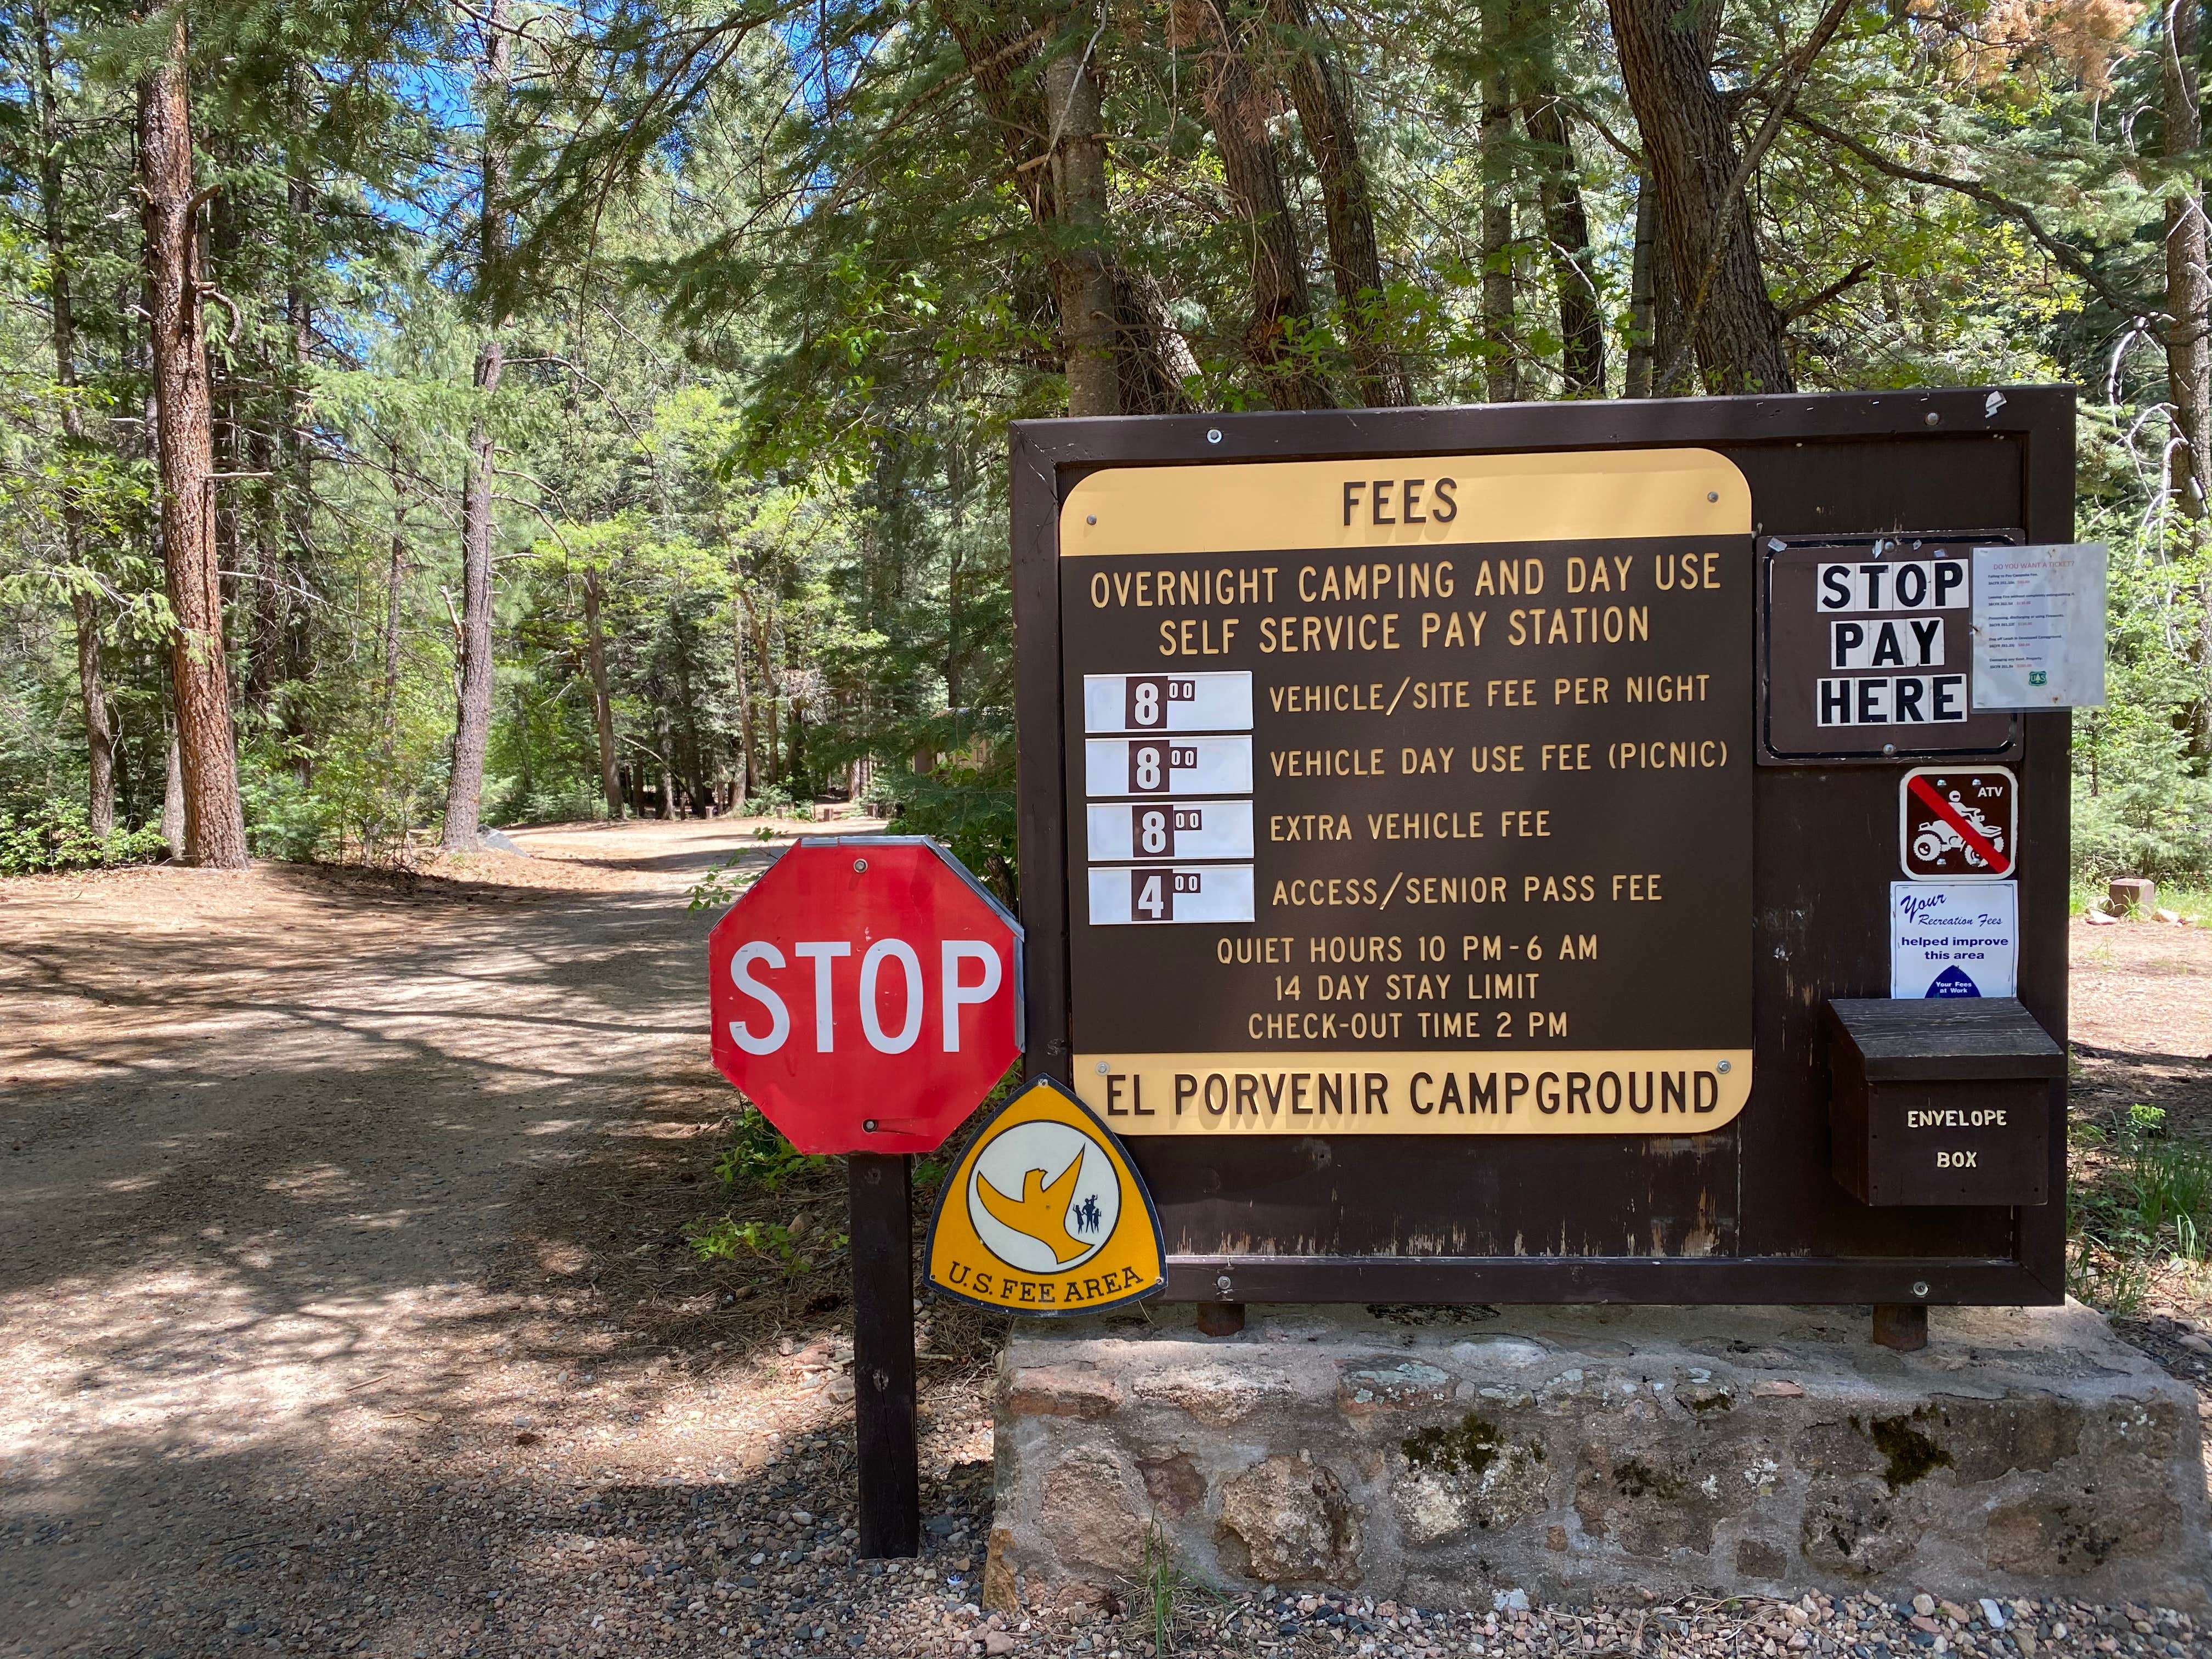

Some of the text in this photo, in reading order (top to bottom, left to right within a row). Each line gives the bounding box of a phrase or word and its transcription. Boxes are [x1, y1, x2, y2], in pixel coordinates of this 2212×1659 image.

[1344, 478, 1457, 526] FEES
[1091, 552, 1721, 608] OVERNIGHT CAMPING AND DAY USE
[1822, 562, 1963, 609] STOP
[1159, 605, 1648, 656] SELF SERVICE PAY STATION
[1836, 620, 1940, 667] PAY
[1269, 674, 1710, 715] VEHICLE/SITE FEE PER NIGHT
[1821, 676, 1963, 724] HERE
[1270, 741, 1728, 777] VEHICLE DAY USE FEE (PICNIC)
[1978, 787, 2003, 797] ATV
[1271, 810, 1551, 842] EXTRA VEHICLE FEE
[1272, 872, 1662, 910] ACCESS/SENIOR PASS FEE
[1900, 894, 1947, 923] Your
[1918, 914, 2002, 927] Recreation Fees
[1217, 937, 1294, 964] QUIET
[1310, 936, 1402, 963] HOURS
[1419, 935, 1445, 962] 10
[1559, 934, 1598, 960] AM
[1901, 937, 2008, 947] helped improve
[1925, 951, 1950, 960] this
[729, 938, 1002, 1056] STOP
[1276, 973, 1539, 1001] 14 DAY STAY LIMIT
[1249, 1012, 1567, 1039] CHECK-OUT TIME 2 PM
[1107, 1071, 1718, 1116] EL PORVENIR CAMPGROUND
[1908, 1109, 2007, 1127] ENVELOPE
[1937, 1151, 1978, 1168] BOX
[949, 1261, 1144, 1303] U.S. FEE AREA
